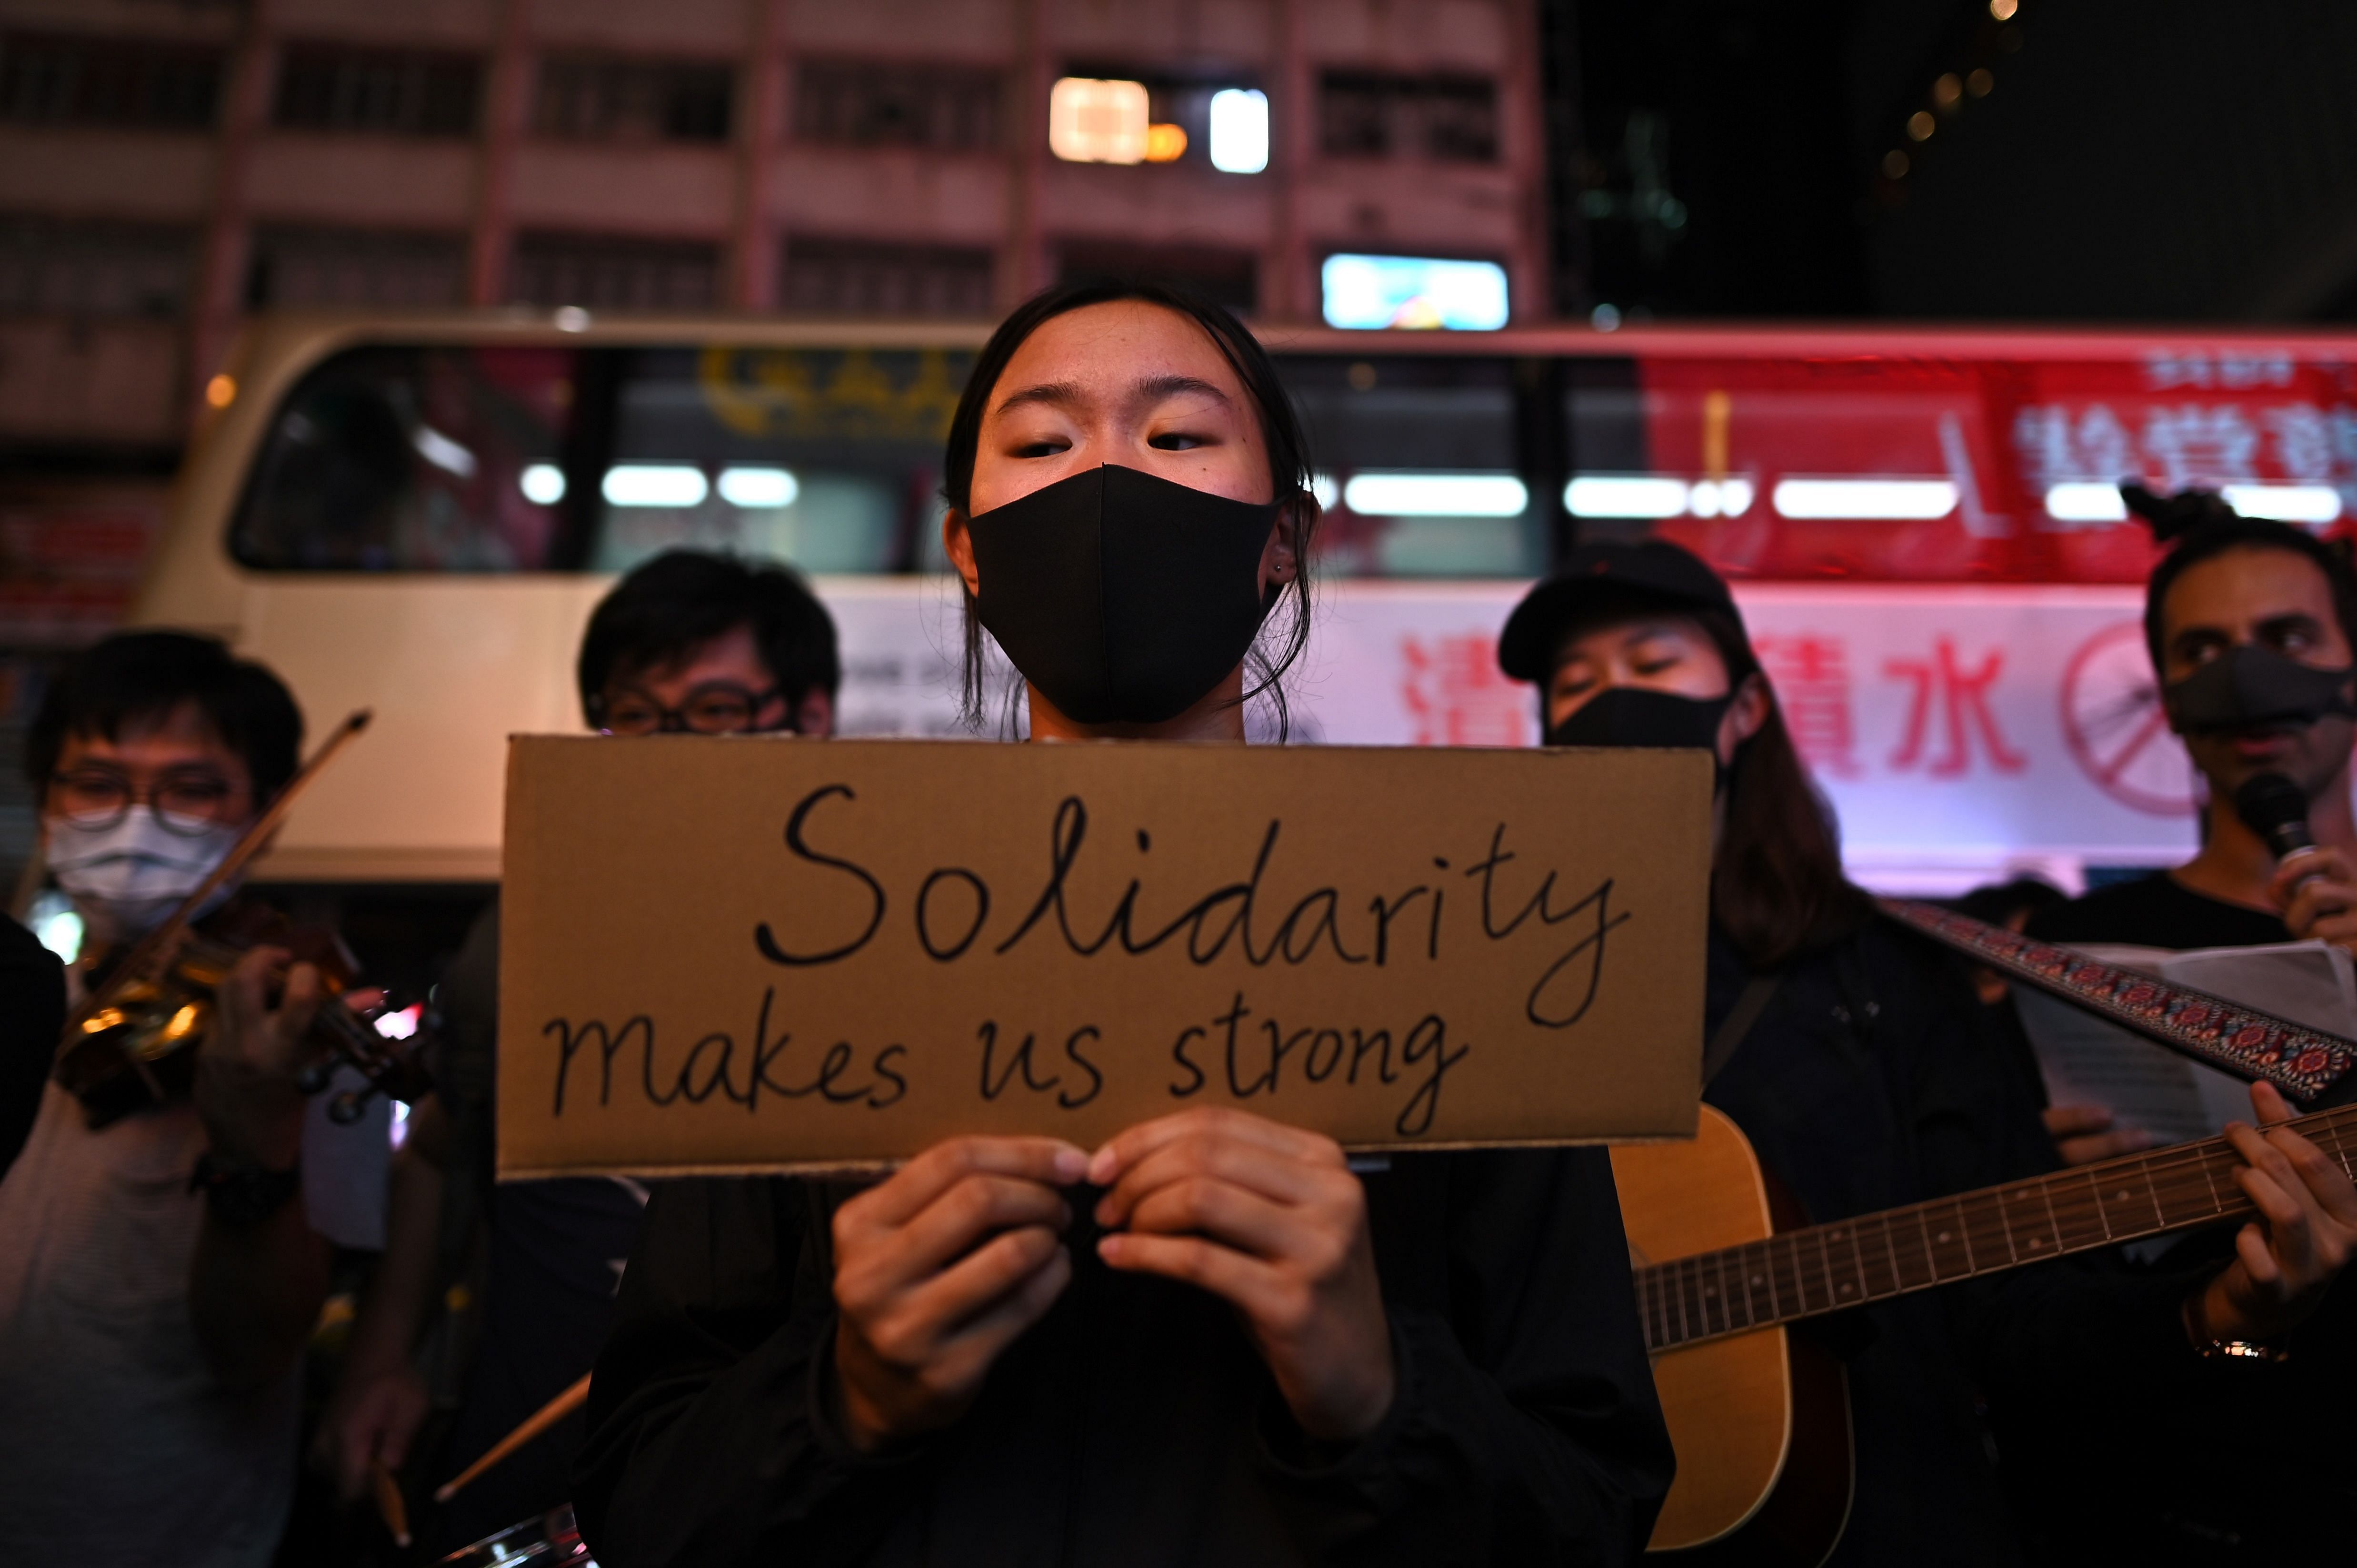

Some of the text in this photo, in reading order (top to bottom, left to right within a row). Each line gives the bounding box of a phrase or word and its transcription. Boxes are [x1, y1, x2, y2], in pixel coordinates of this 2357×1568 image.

[755, 784, 1630, 1028] Solidarity
[543, 989, 1470, 1139] makes us strong
